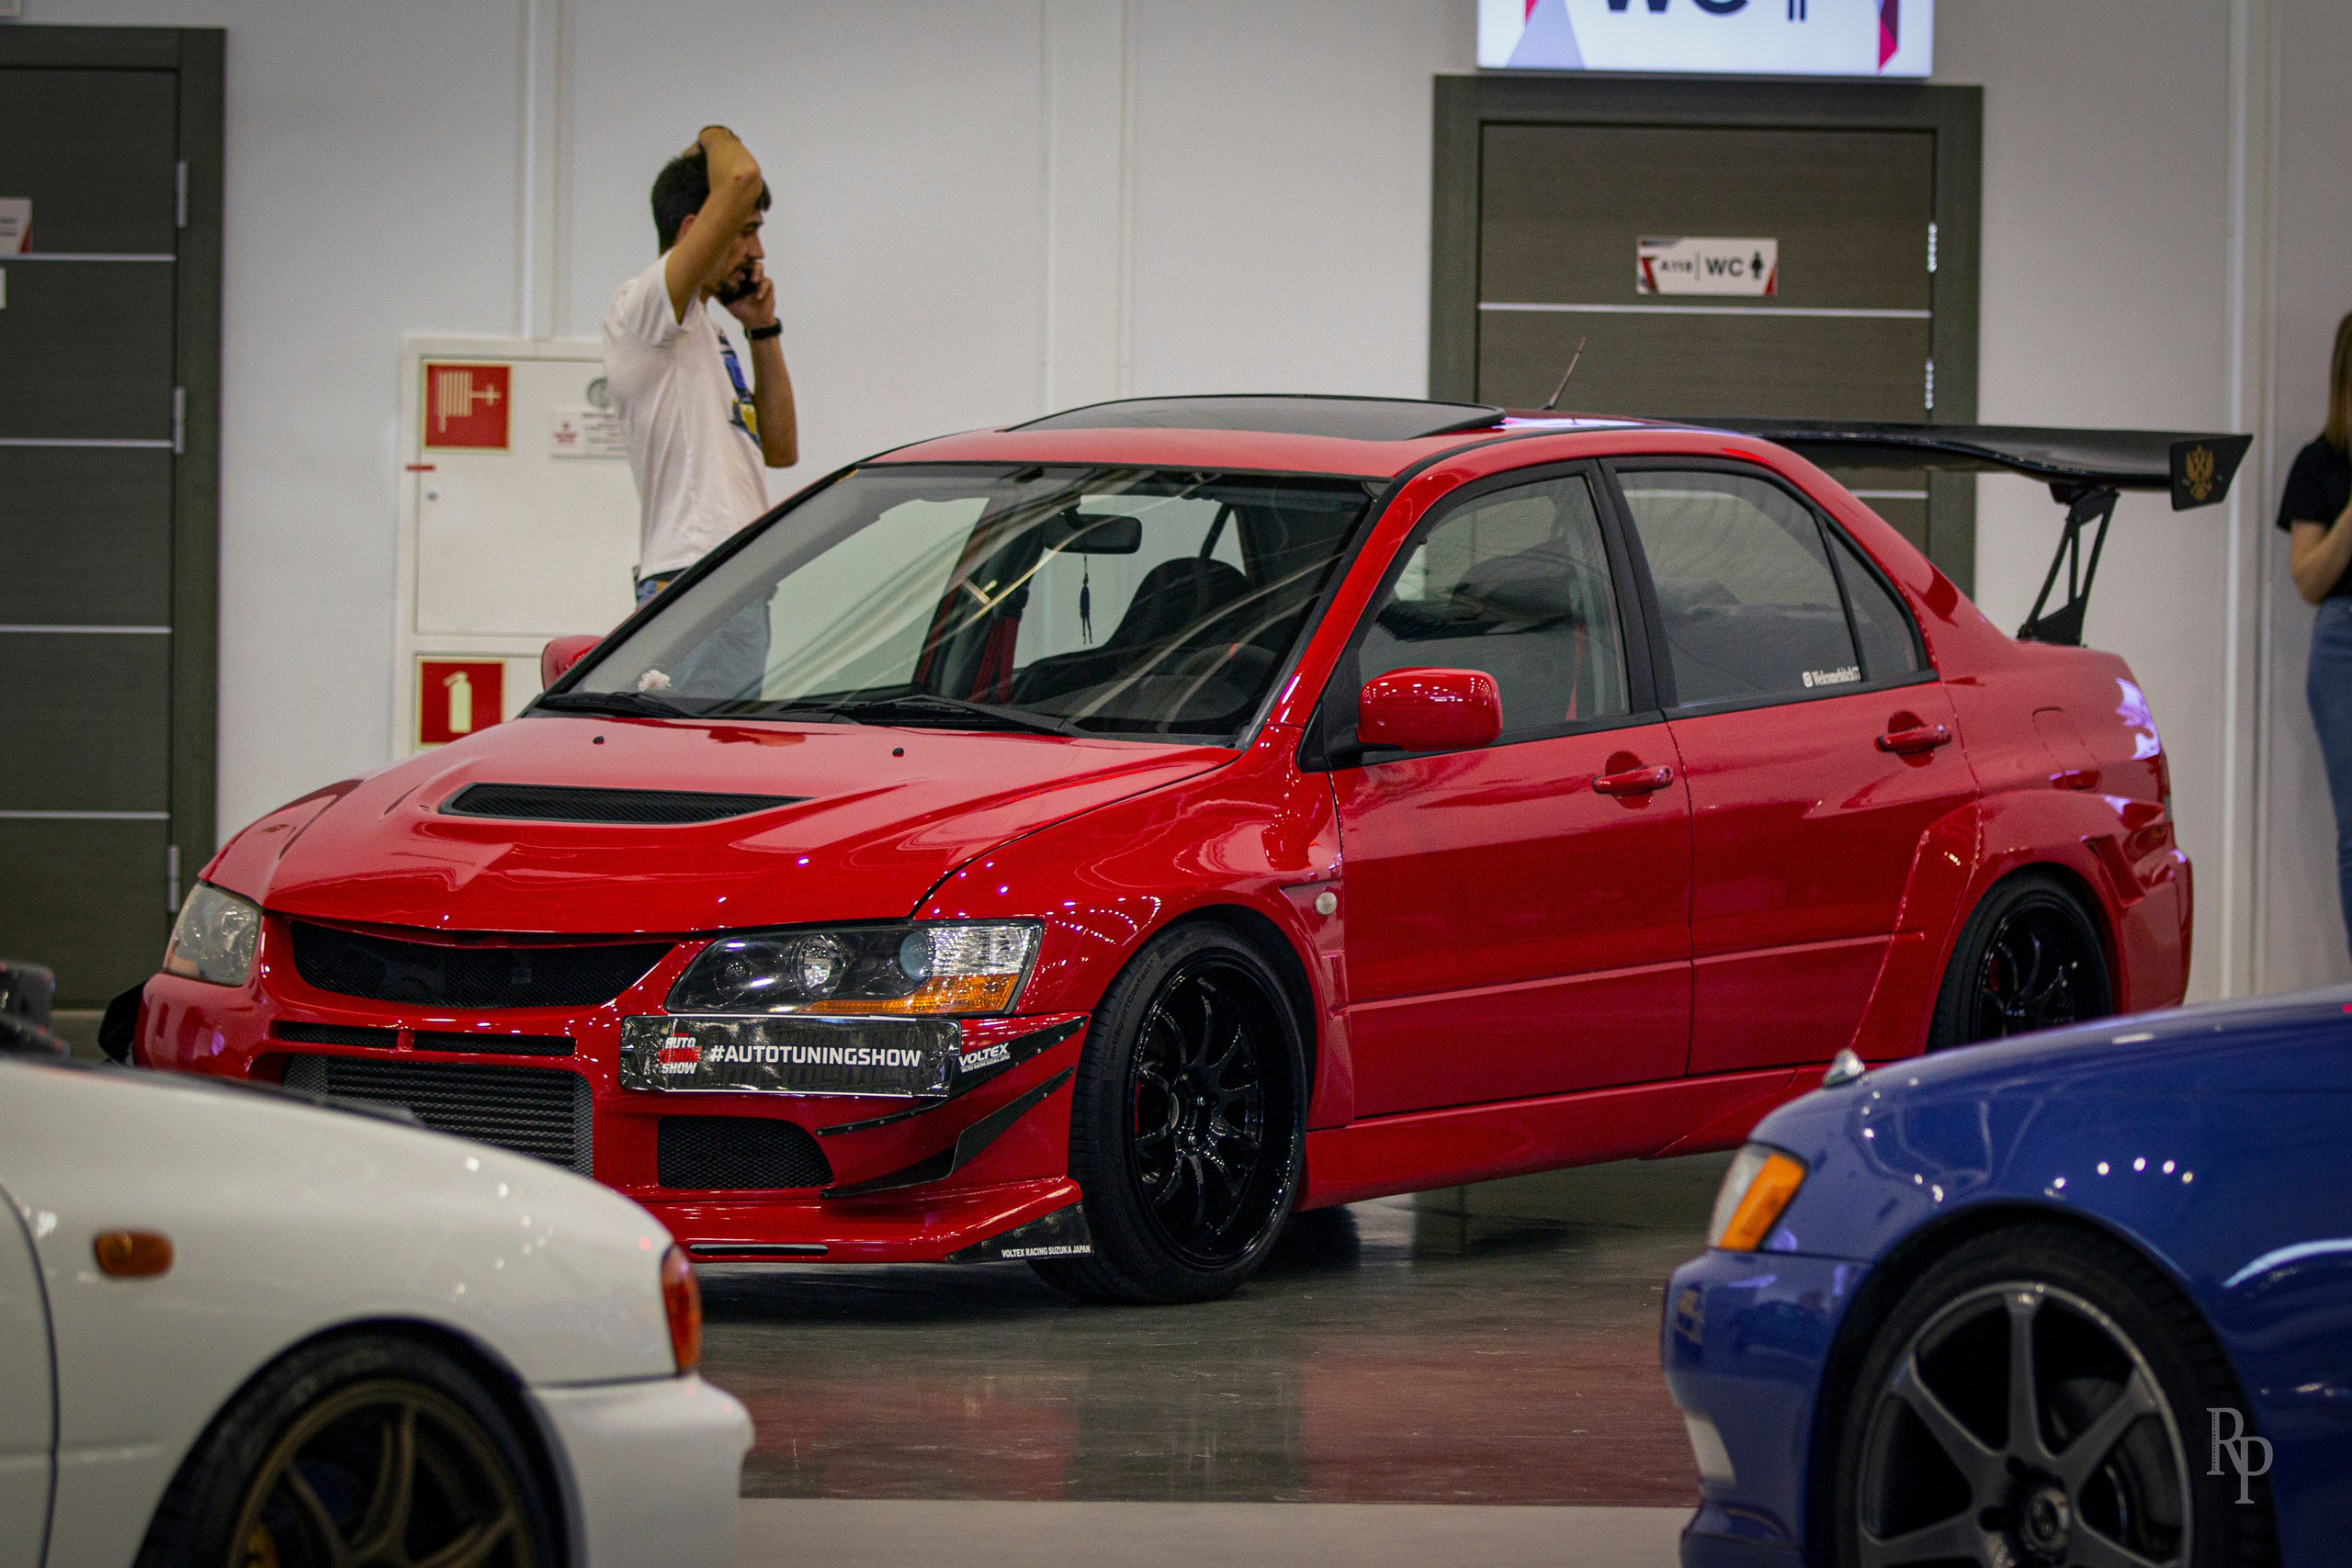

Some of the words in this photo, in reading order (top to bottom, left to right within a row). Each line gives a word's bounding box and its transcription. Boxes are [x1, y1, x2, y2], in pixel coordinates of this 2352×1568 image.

[1705, 256, 1744, 276] WC
[665, 1037, 696, 1048] AUTO
[658, 1046, 703, 1065] TUNING
[710, 1045, 922, 1067] #AUTOTUNINGSHOW
[958, 1043, 1010, 1066] VOLTEX
[662, 1062, 697, 1074] SHOW
[1001, 1248, 1025, 1258] VOLTEX
[1025, 1247, 1047, 1257] RACING
[1048, 1246, 1072, 1255] SUZUKA
[1073, 1245, 1091, 1253] JAPAN
